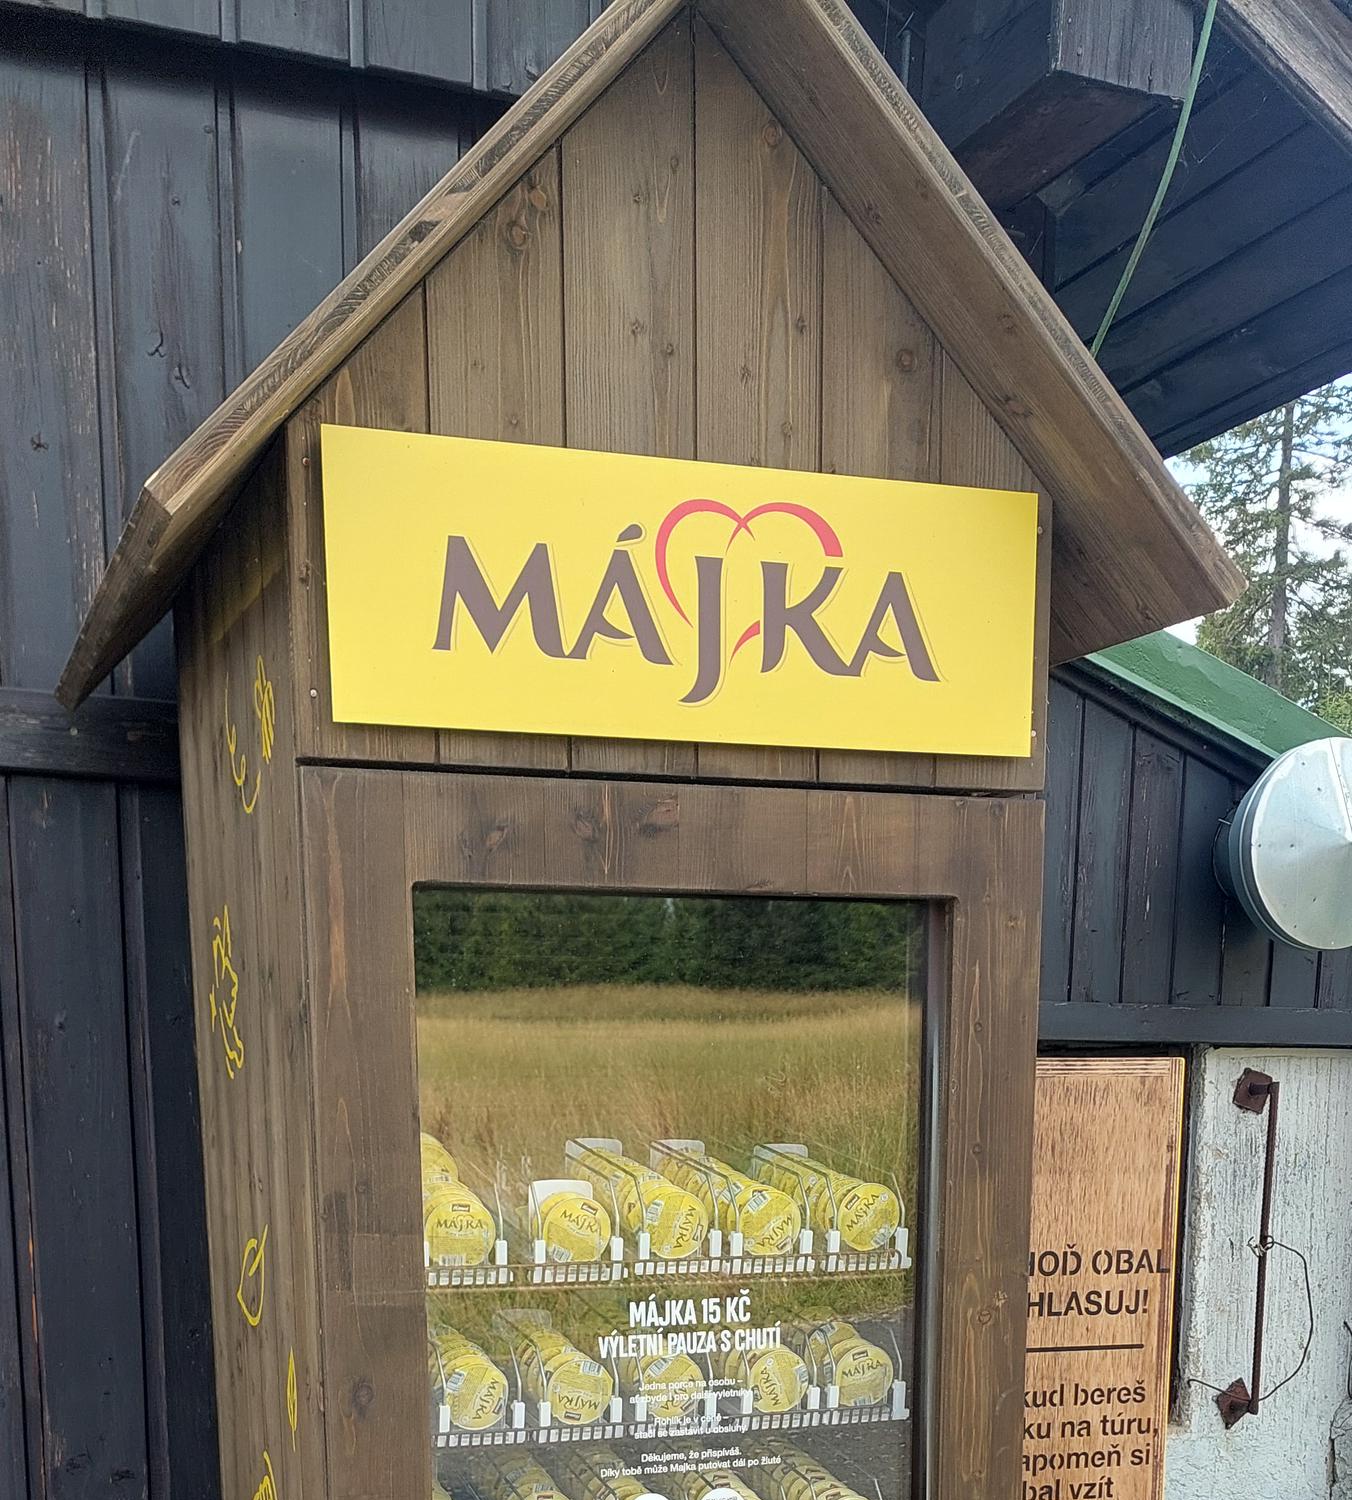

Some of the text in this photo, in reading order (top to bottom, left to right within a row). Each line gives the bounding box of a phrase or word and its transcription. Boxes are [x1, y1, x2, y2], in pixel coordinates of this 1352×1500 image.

[432, 521, 942, 704] MÁJKA
[436, 1216, 484, 1232] MÁJKA
[1092, 1248, 1171, 1275] OBAL
[629, 1289, 751, 1328] MÁJKA 15 KČ
[1027, 1289, 1149, 1318] HLASUJ!
[598, 1321, 781, 1359] VÝLETNÍ PAUZA S CHUTÍ
[842, 1358, 883, 1379] MÁJKA
[639, 1381, 666, 1391] Jedna
[668, 1381, 694, 1393] porce
[696, 1380, 706, 1388] na
[708, 1377, 736, 1387] osobu
[1074, 1380, 1145, 1406] bereš
[1061, 1419, 1091, 1439] na
[1100, 1412, 1159, 1439] túru,
[641, 1446, 742, 1464] Děkujeme, že přispíváš.
[1130, 1443, 1151, 1466] si
[600, 1467, 620, 1479] Díky
[622, 1465, 642, 1476] tobě
[644, 1463, 668, 1475] může
[698, 1459, 731, 1472] putovat
[732, 1457, 746, 1468] dál
[748, 1459, 759, 1469] po
[1070, 1477, 1113, 1500] vzít
